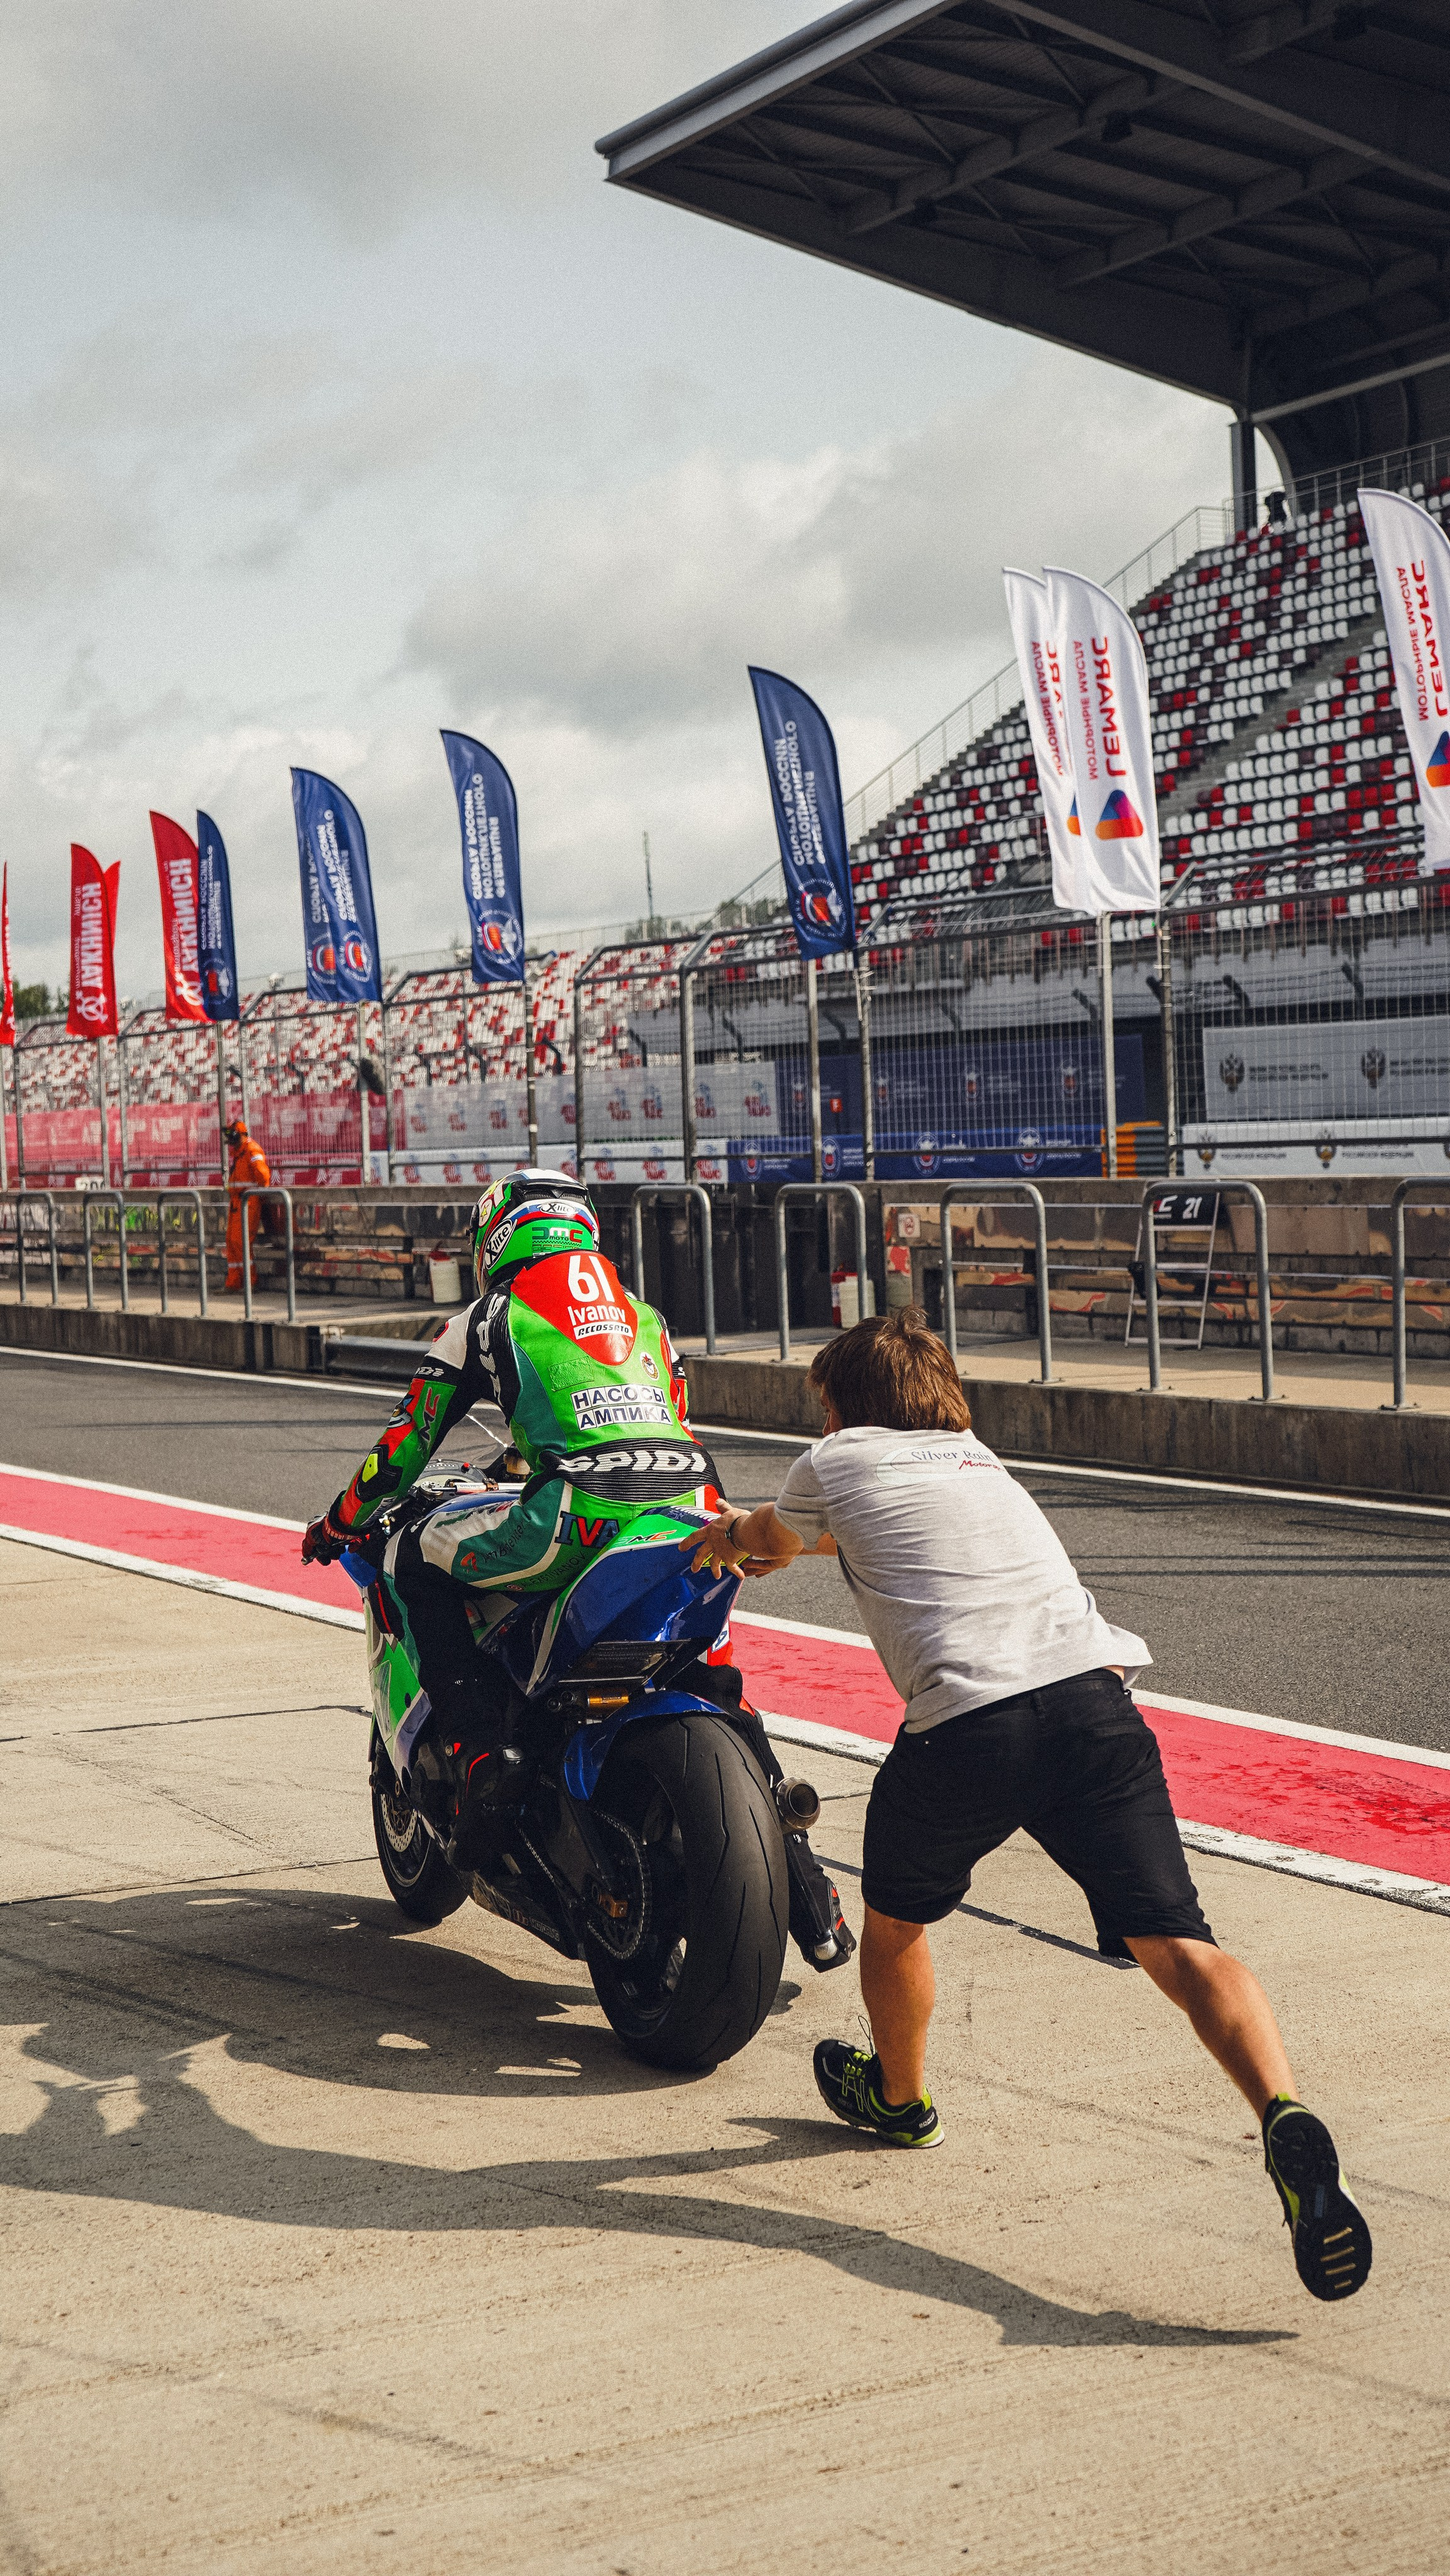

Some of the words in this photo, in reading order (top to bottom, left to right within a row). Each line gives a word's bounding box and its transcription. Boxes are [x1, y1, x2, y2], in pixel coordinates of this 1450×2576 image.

[547, 1202, 571, 1213] X-lite
[1183, 1197, 1203, 1219] 21
[485, 1226, 510, 1265] X-lite
[568, 1255, 615, 1302] 61
[567, 1304, 626, 1326] Ivanov
[574, 1386, 666, 1409] НАСОСЫ
[580, 1407, 671, 1429] АМПИКА
[557, 1450, 706, 1473] SPIDI
[912, 1450, 957, 1461] Silver
[963, 1450, 993, 1462] Rain
